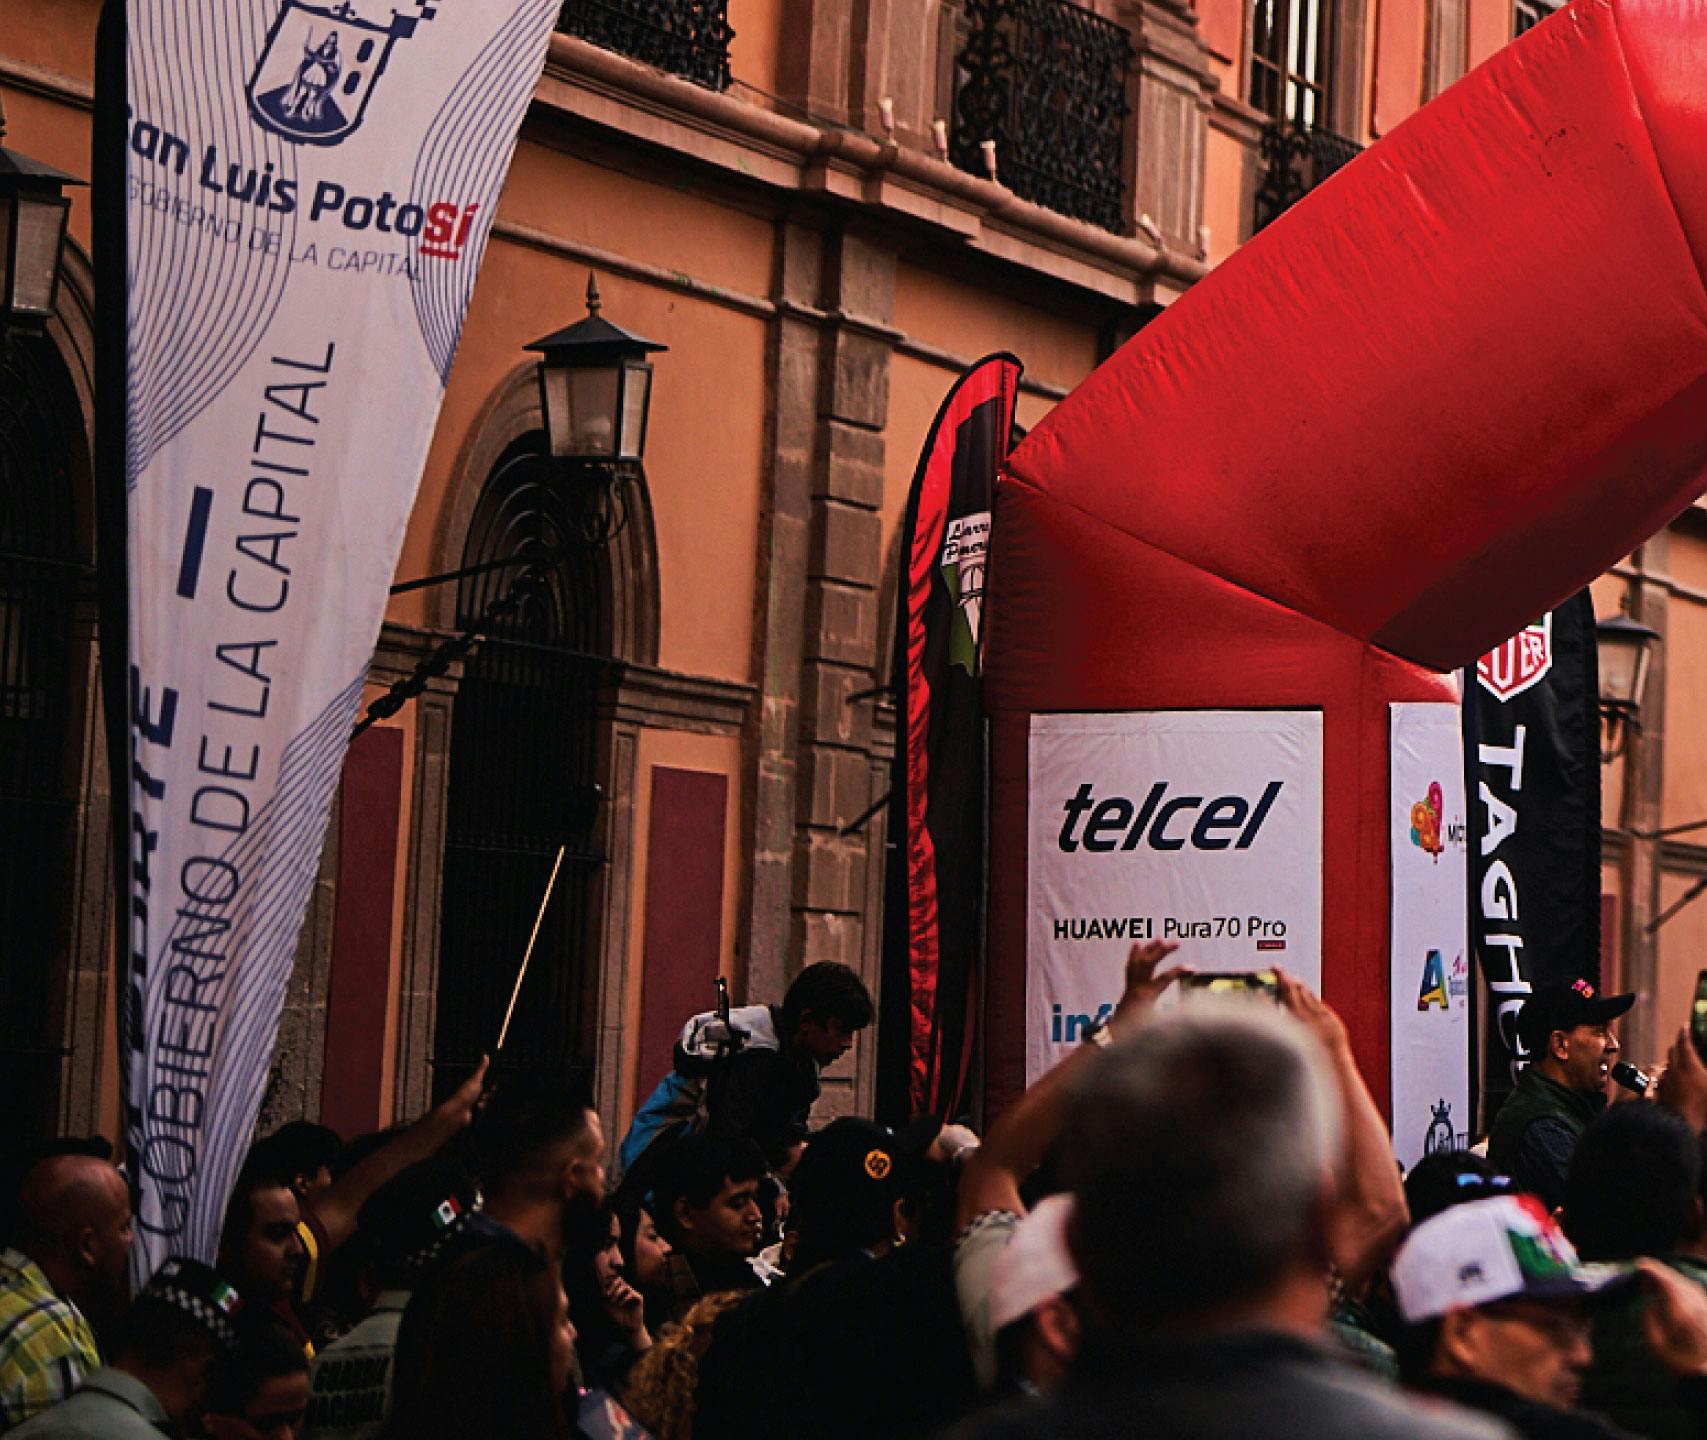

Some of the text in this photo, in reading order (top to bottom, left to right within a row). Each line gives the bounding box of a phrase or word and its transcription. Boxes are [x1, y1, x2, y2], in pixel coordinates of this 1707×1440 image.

[127, 103, 191, 176] an
[199, 144, 299, 216] Luis
[289, 242, 319, 266] LA
[326, 245, 424, 282] CAPITAL
[226, 340, 337, 614] CAPITAL
[206, 638, 280, 720] LA
[188, 734, 262, 835] DE
[1058, 781, 1284, 852] telcel
[1054, 915, 1287, 940] HUAWEI Pura70 Pro
[137, 855, 241, 1240] GOBIERNO
